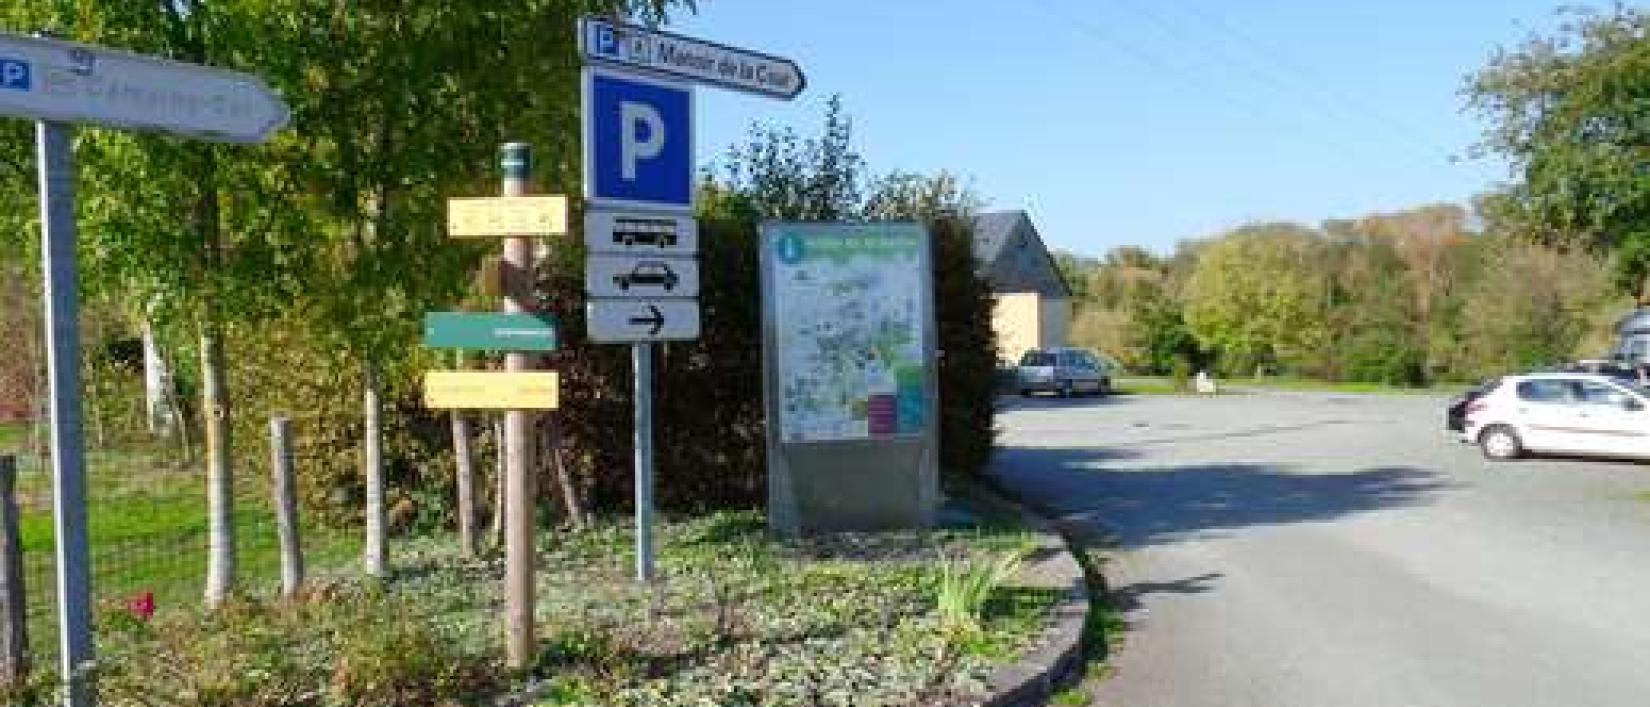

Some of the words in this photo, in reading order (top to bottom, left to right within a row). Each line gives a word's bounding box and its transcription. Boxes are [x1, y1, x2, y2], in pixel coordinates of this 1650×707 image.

[600, 30, 614, 52] P
[3, 62, 24, 87] P
[621, 101, 664, 179] P
